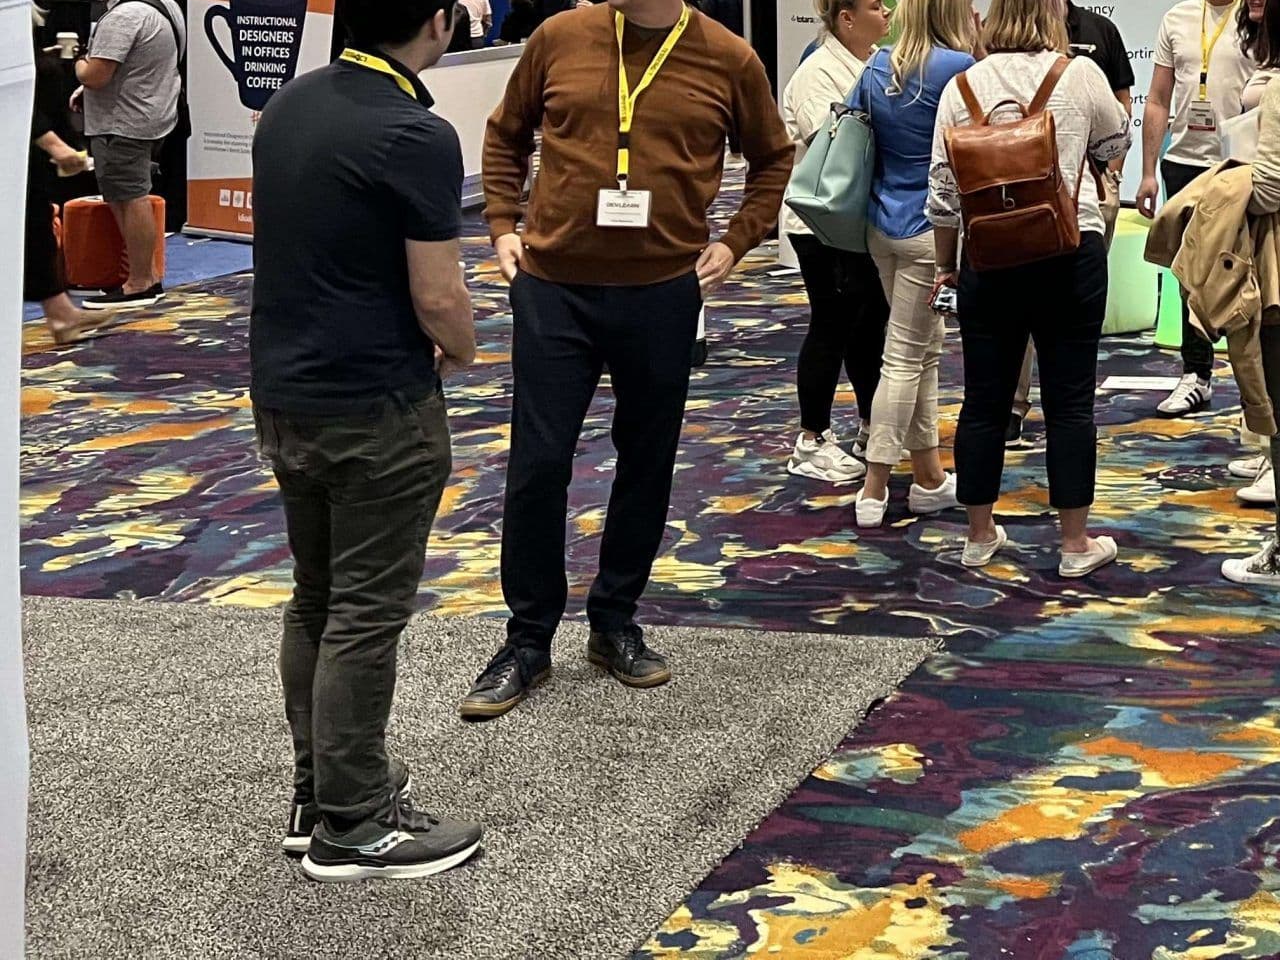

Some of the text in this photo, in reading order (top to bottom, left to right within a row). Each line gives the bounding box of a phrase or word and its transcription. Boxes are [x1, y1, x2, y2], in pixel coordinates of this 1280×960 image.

[1089, 3, 1115, 17] ancy
[237, 15, 297, 27] INSTRUCTIONAL
[239, 29, 295, 43] DESIGNERS
[242, 46, 290, 59] IN OFFICES
[244, 61, 287, 74] DRINKING
[246, 76, 283, 90] COFFEE
